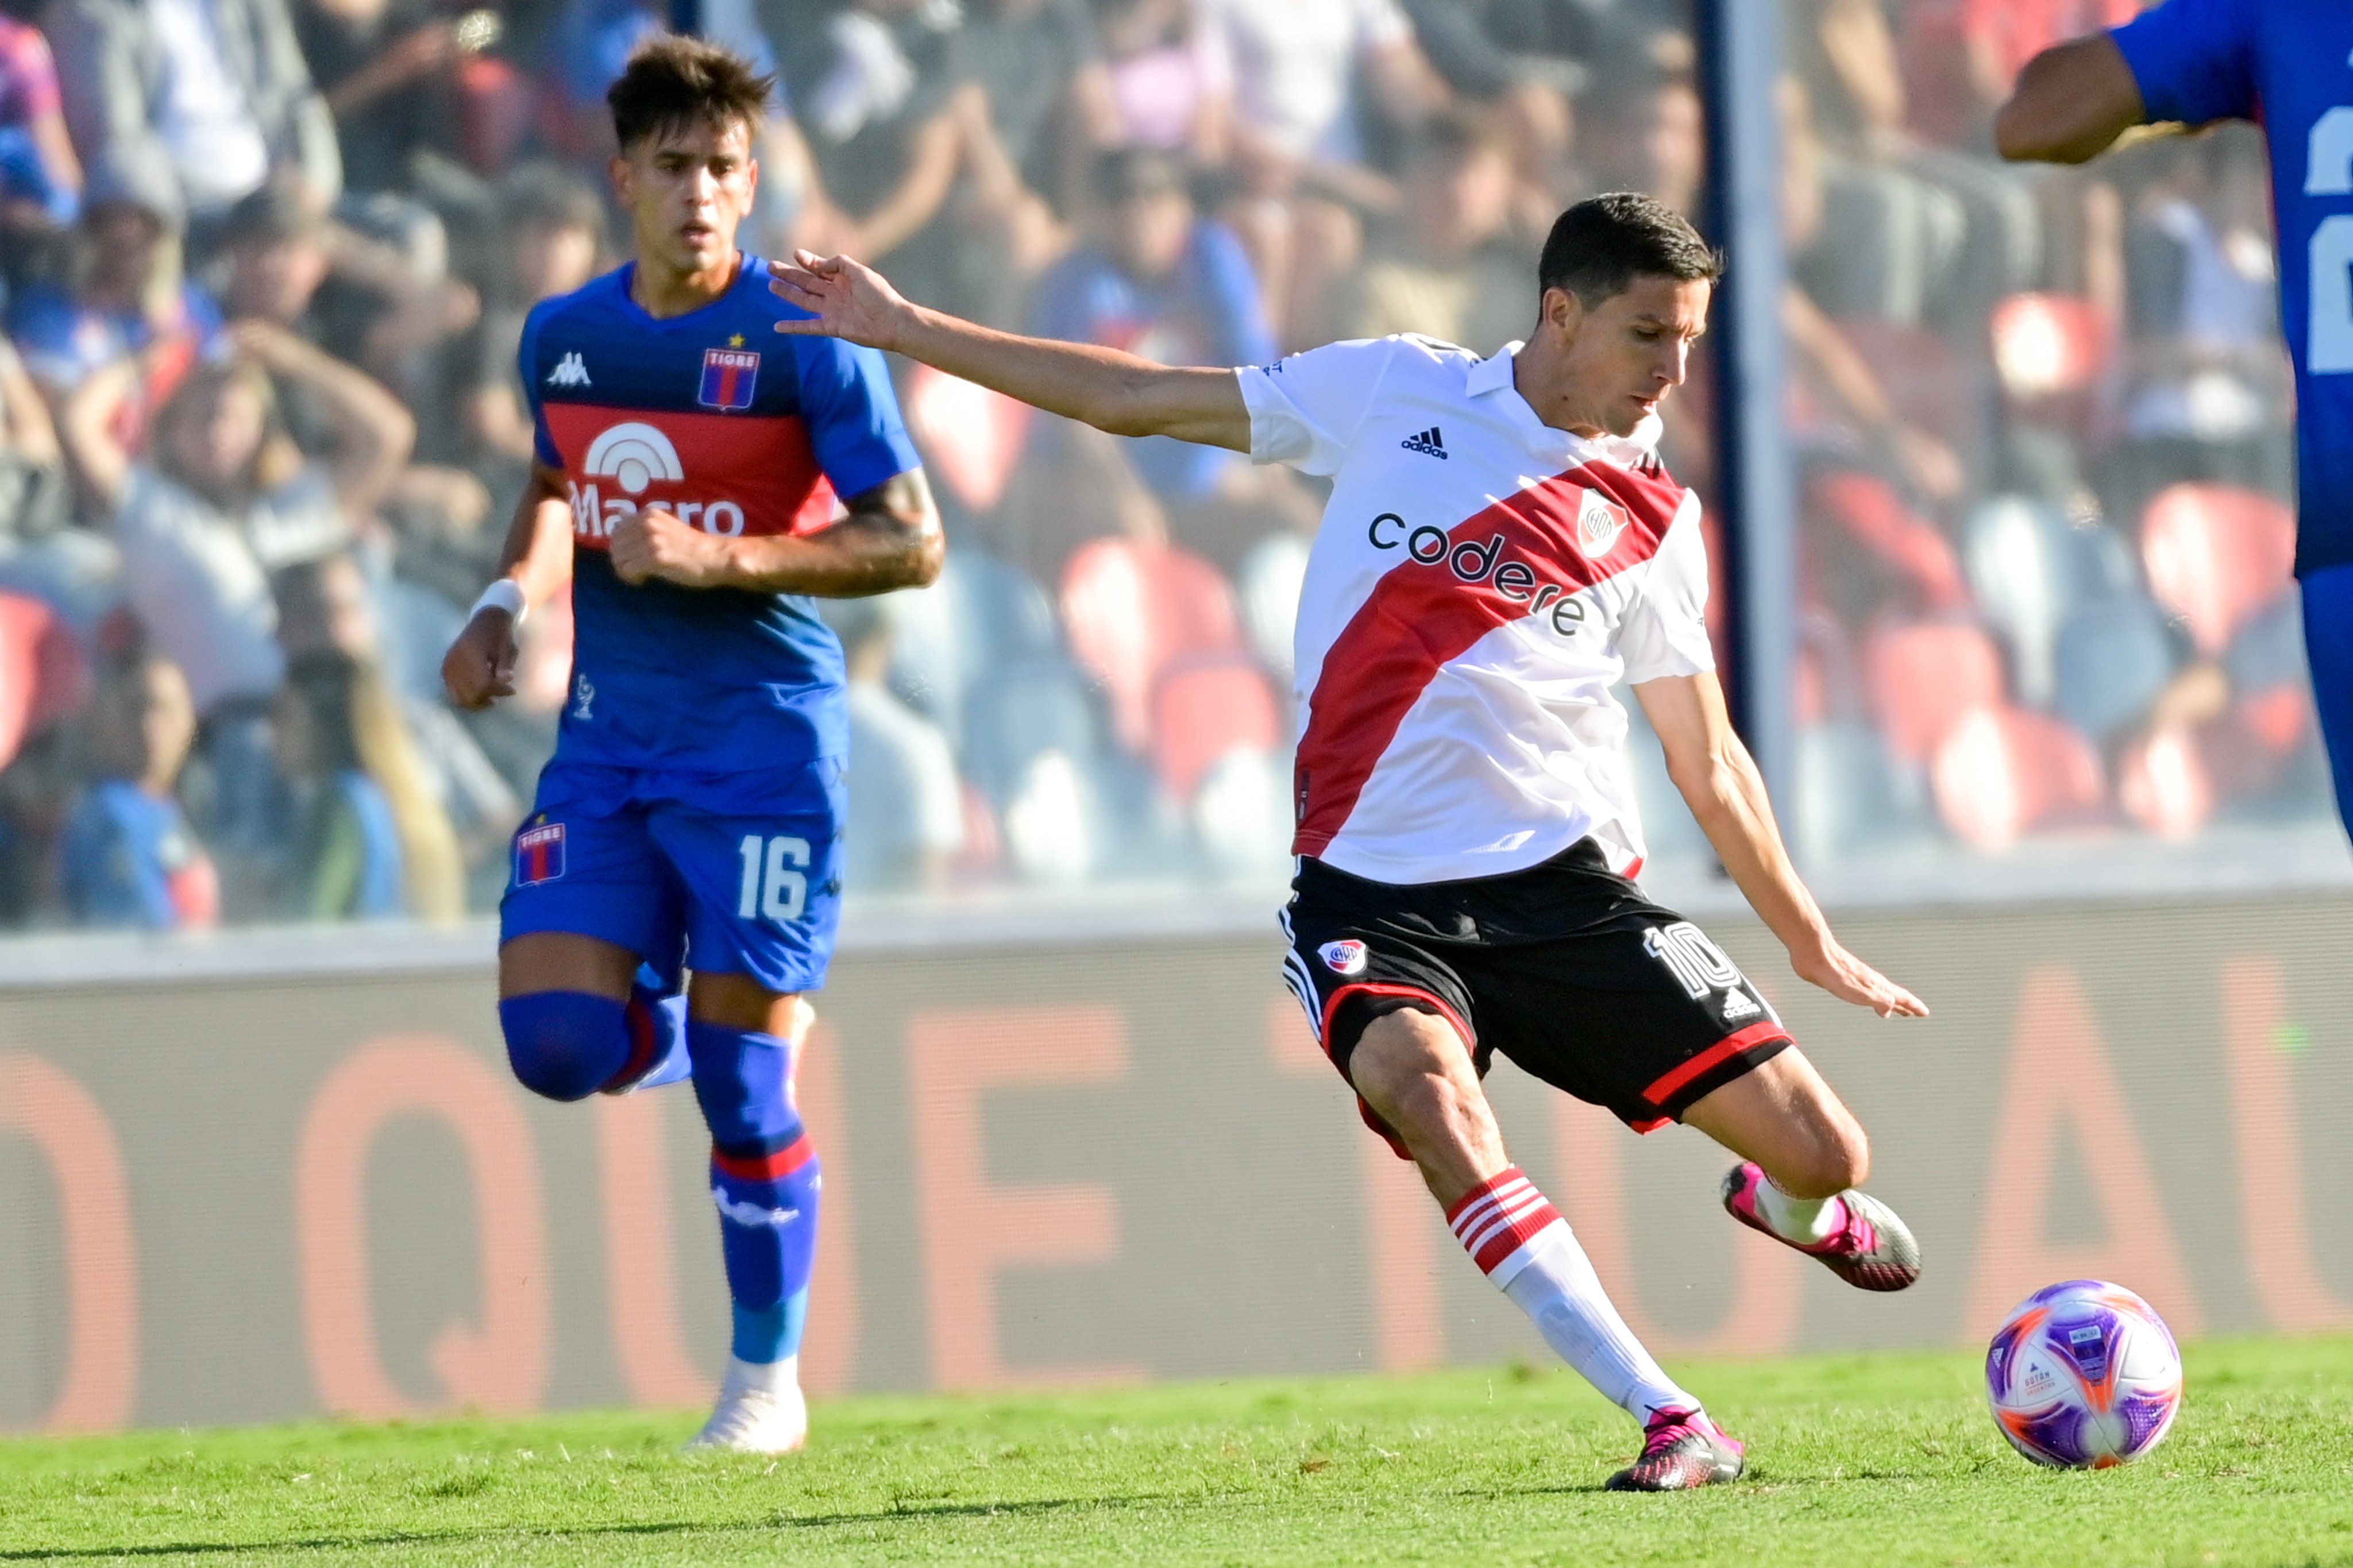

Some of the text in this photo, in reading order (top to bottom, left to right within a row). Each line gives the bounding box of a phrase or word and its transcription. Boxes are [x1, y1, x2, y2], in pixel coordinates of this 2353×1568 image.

[710, 352, 755, 367] TIGRE
[1401, 440, 1448, 460] adidas
[567, 480, 745, 537] Maro
[1369, 512, 1585, 636] codere
[522, 827, 561, 848] TIGRE
[739, 835, 811, 921] 16
[1643, 921, 1741, 1000] 10
